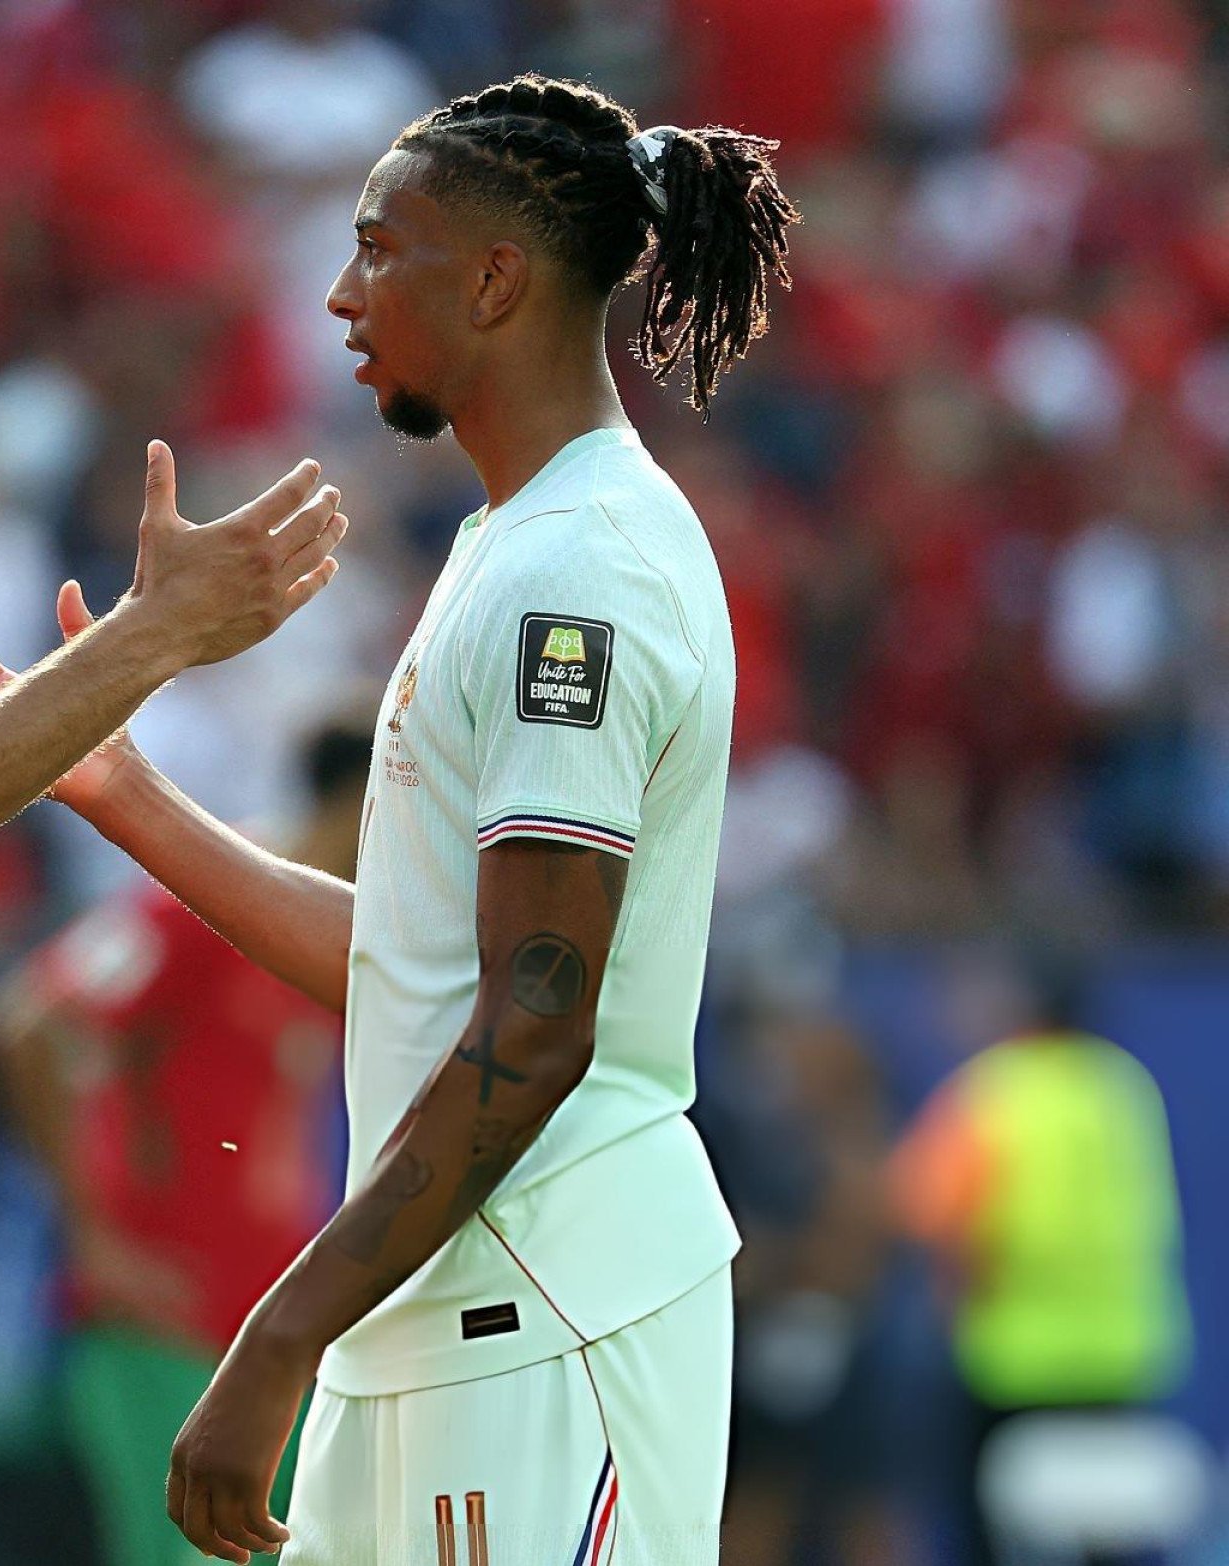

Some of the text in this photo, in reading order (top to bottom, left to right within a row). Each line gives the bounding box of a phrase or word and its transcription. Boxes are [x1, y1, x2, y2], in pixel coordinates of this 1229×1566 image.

[537, 661, 587, 683] Unite For
[530, 682, 592, 705] EDUCATION
[544, 701, 569, 714] FIFA
